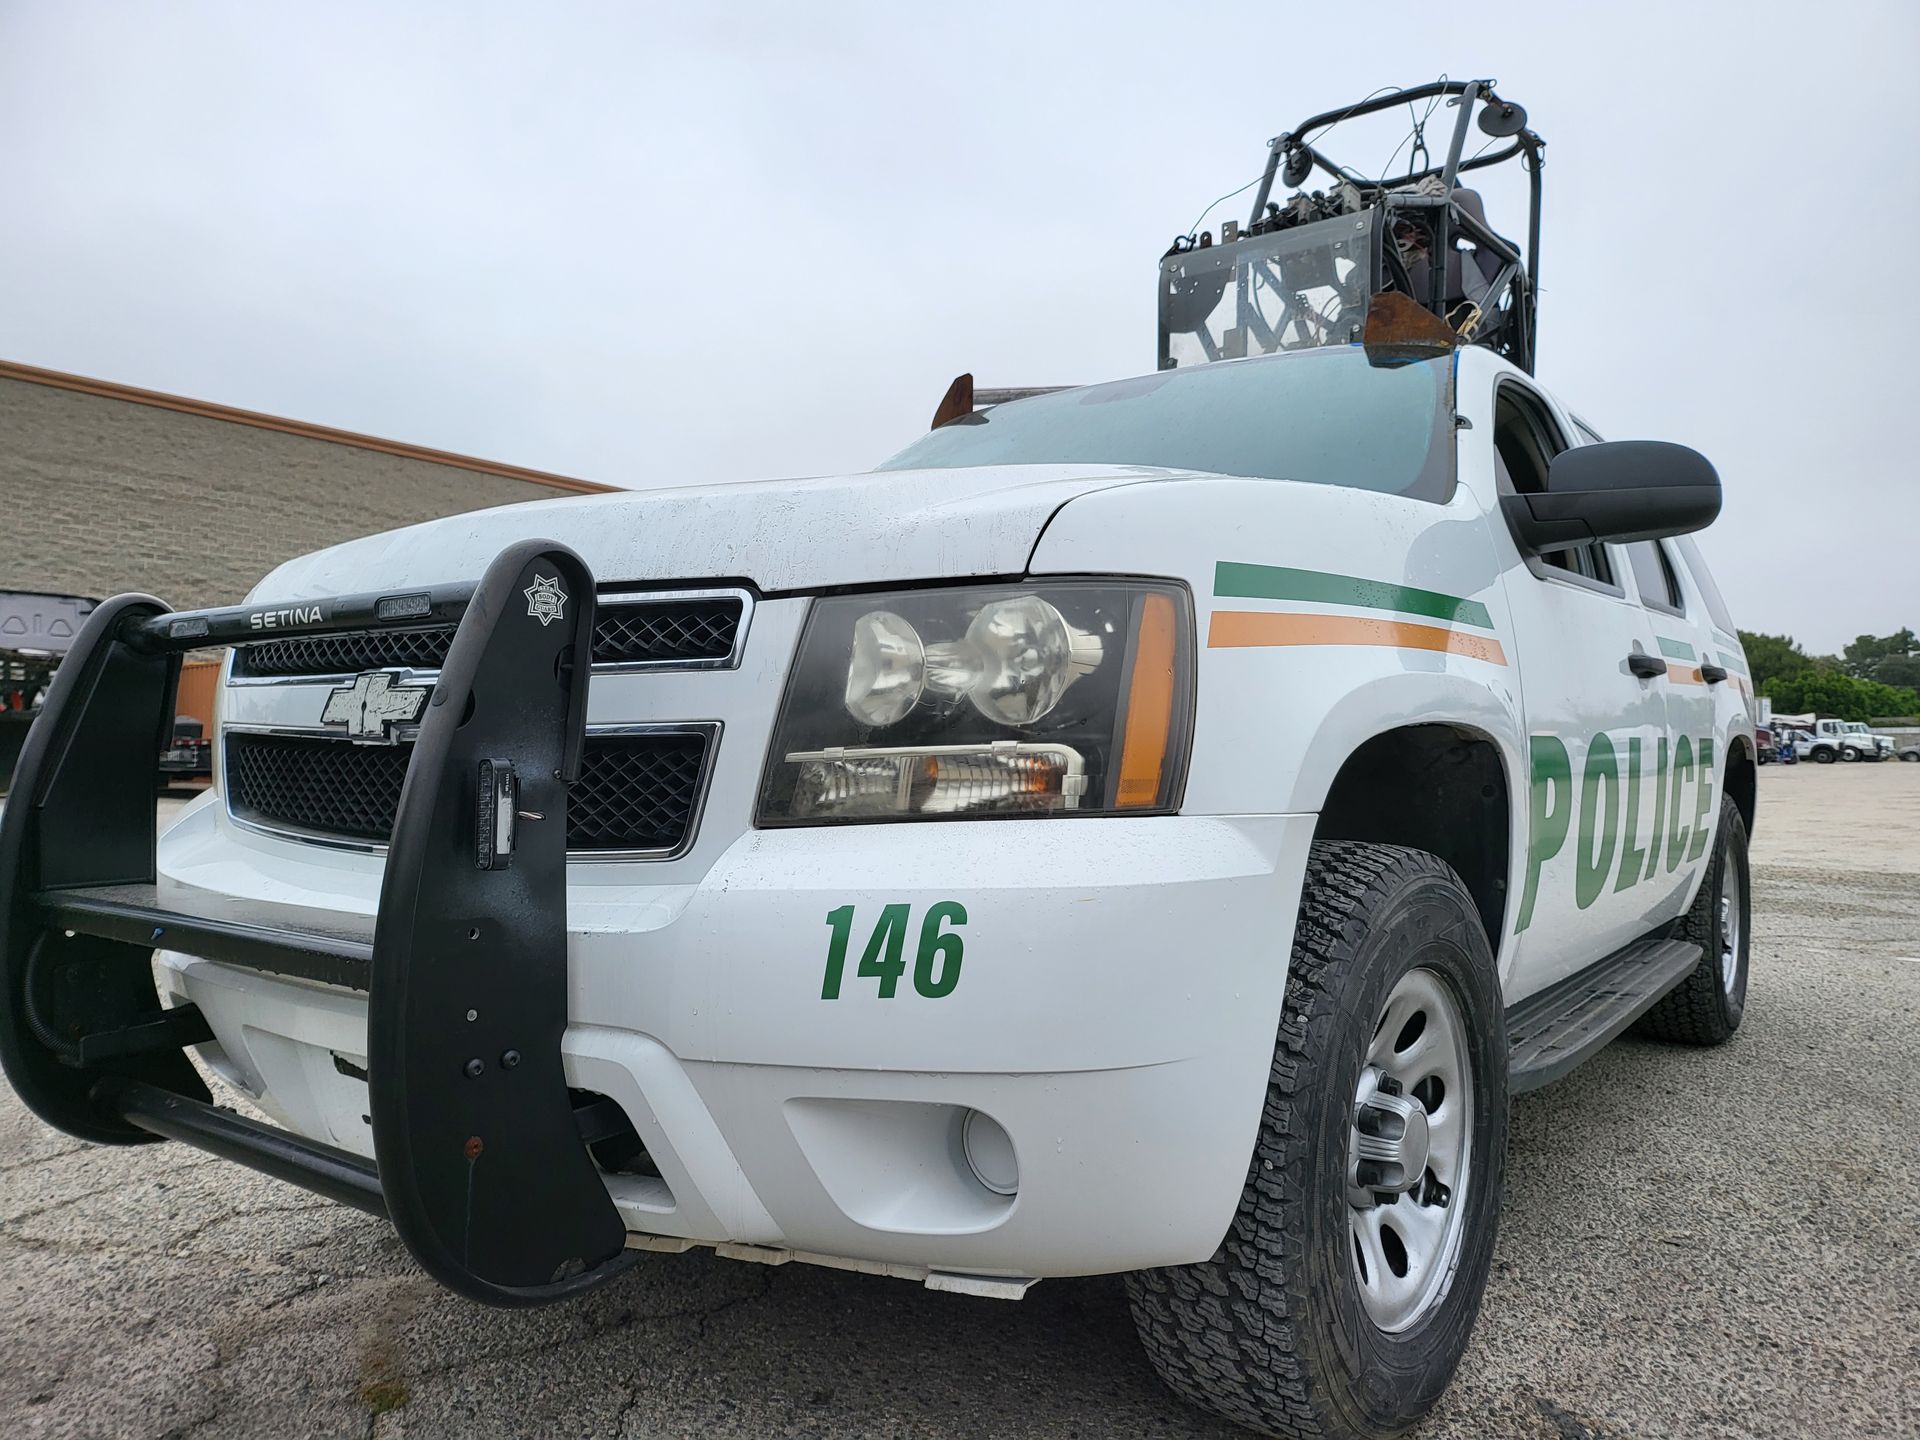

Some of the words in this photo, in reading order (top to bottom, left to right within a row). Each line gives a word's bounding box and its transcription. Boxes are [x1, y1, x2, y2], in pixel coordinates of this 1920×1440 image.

[250, 606, 323, 630] SETINA
[1514, 732, 1714, 935] POLICE
[821, 901, 968, 1000] 146
